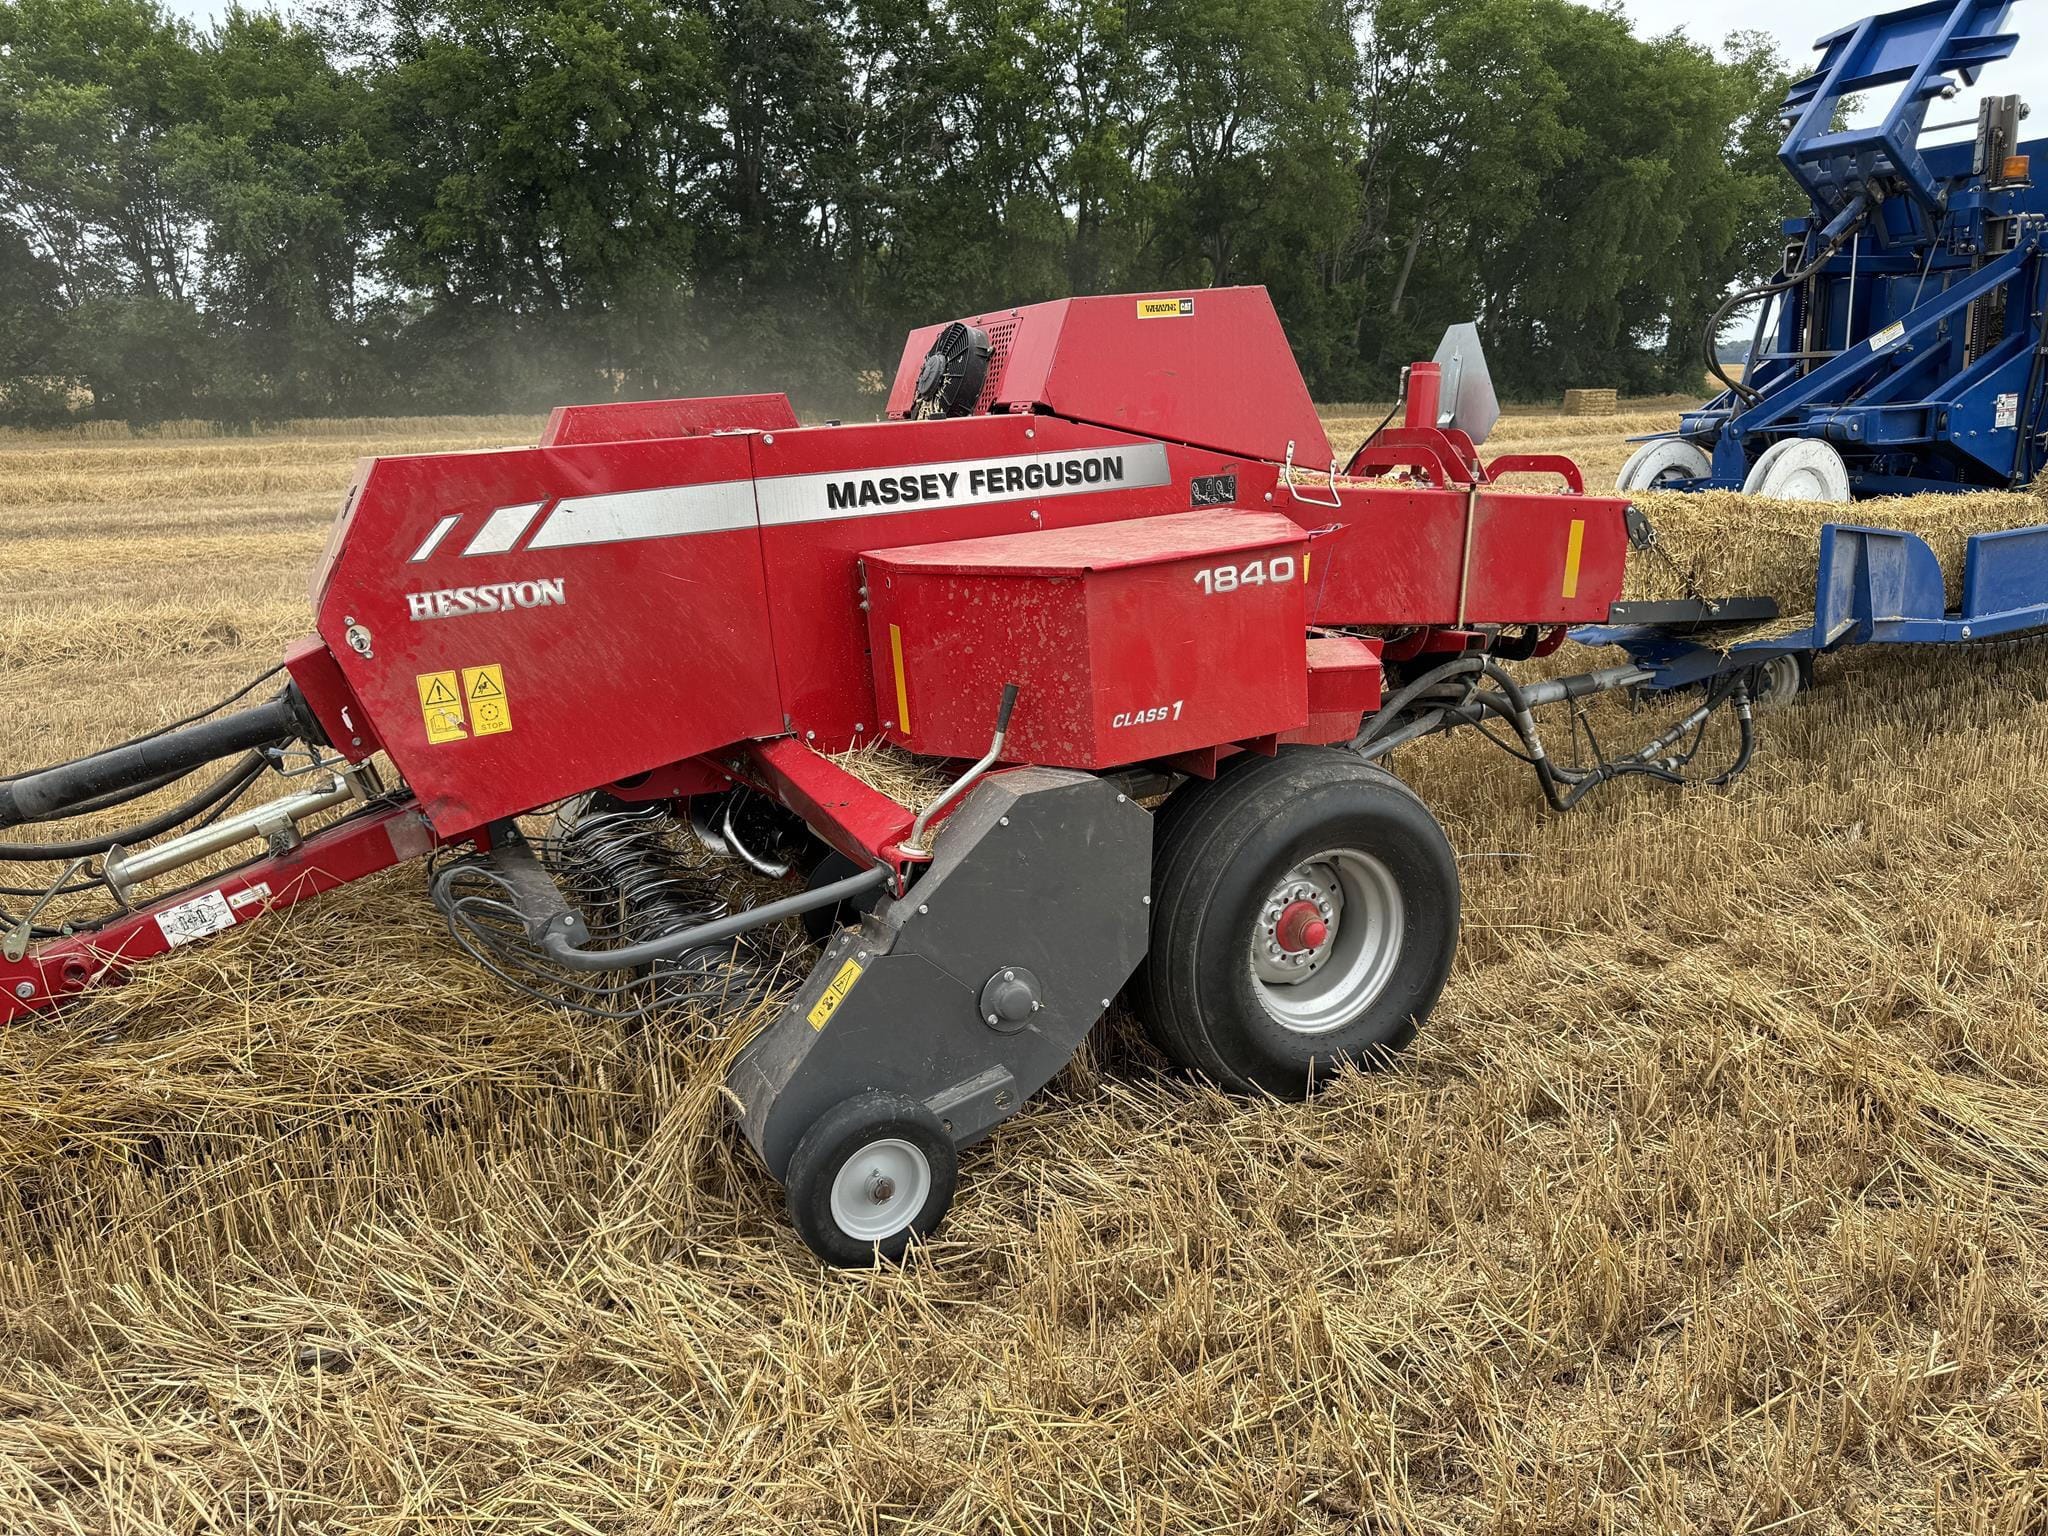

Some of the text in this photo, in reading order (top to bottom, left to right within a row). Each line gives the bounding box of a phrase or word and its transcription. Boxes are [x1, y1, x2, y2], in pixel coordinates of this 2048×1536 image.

[1180, 302, 1192, 311] CAT
[826, 455, 1124, 509] MASSEY FERGUSON
[1193, 556, 1295, 595] 1840
[406, 577, 566, 621] HESSTON
[481, 721, 504, 731] STOP
[1112, 700, 1184, 729] CLASS 1
